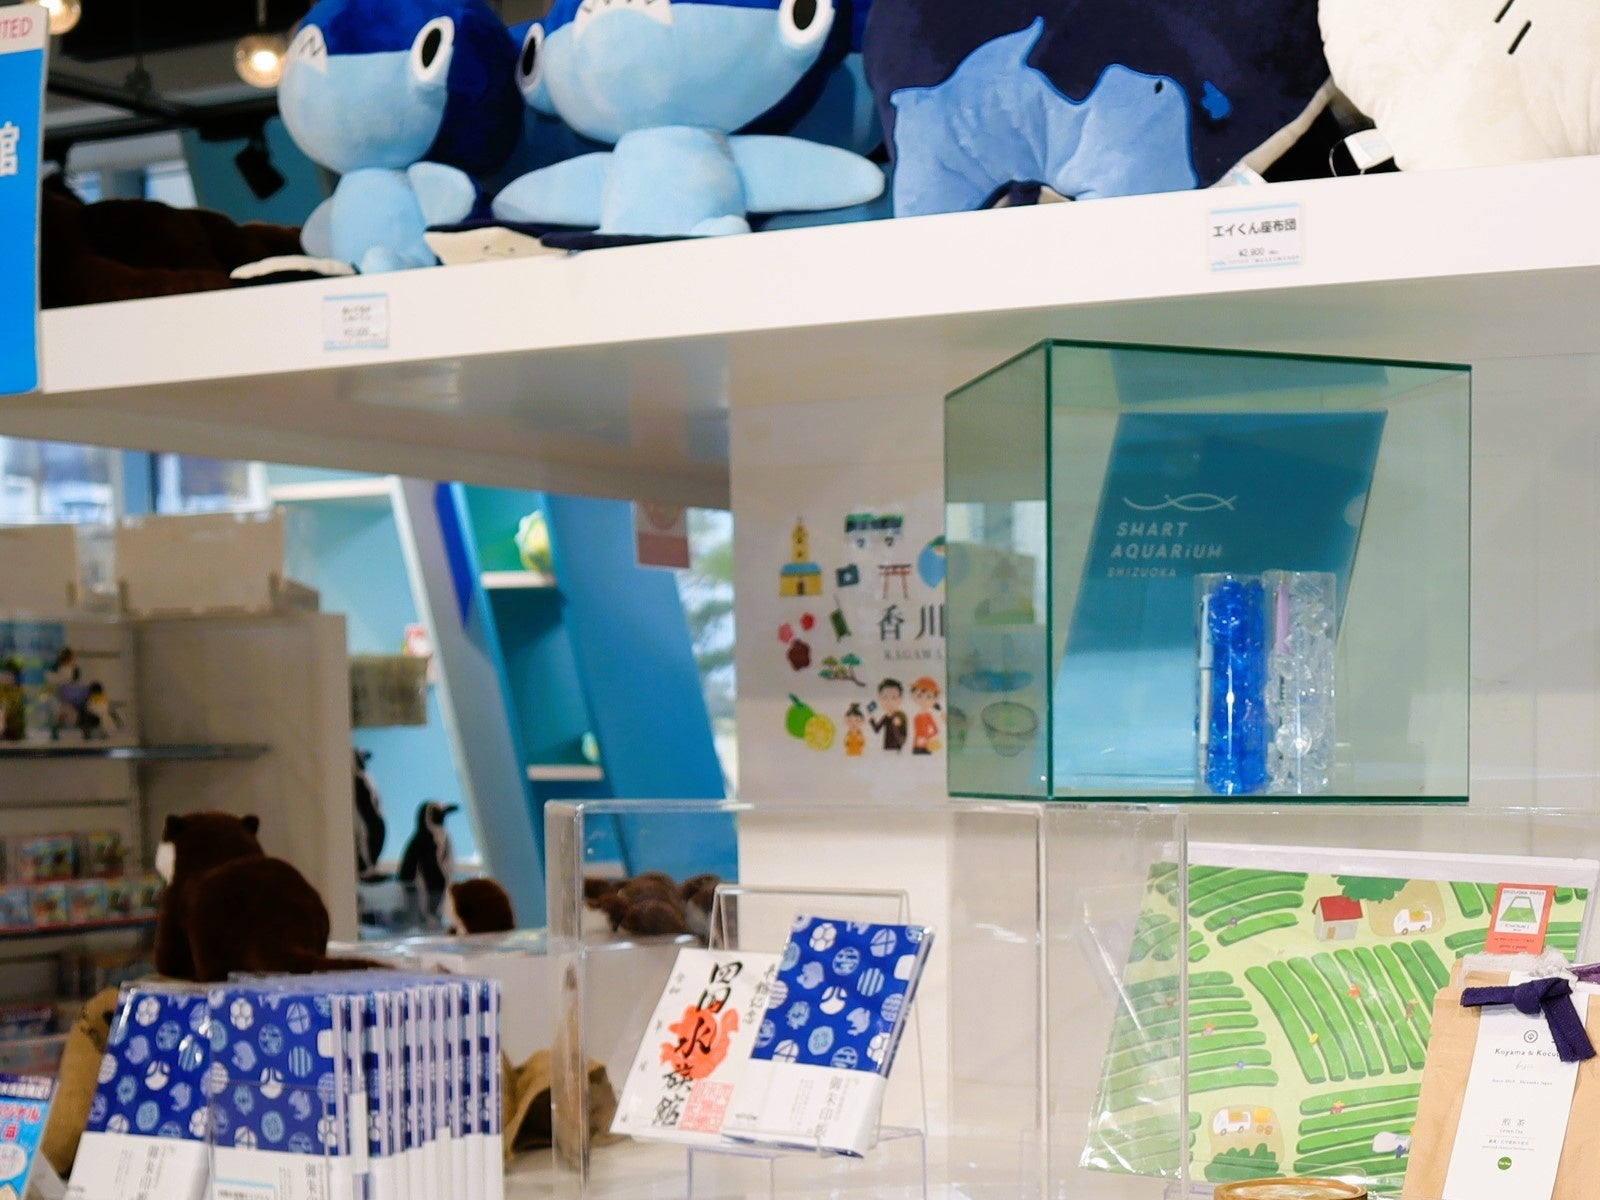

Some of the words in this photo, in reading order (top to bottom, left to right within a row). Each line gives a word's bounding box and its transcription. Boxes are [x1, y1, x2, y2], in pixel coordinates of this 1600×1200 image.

[1212, 217, 1297, 237] エイくん座布団
[1116, 521, 1189, 537] SMART
[1107, 567, 1177, 578] SHIZUOKA
[877, 604, 945, 641] 香川
[1494, 1048, 1525, 1057] Koyama
